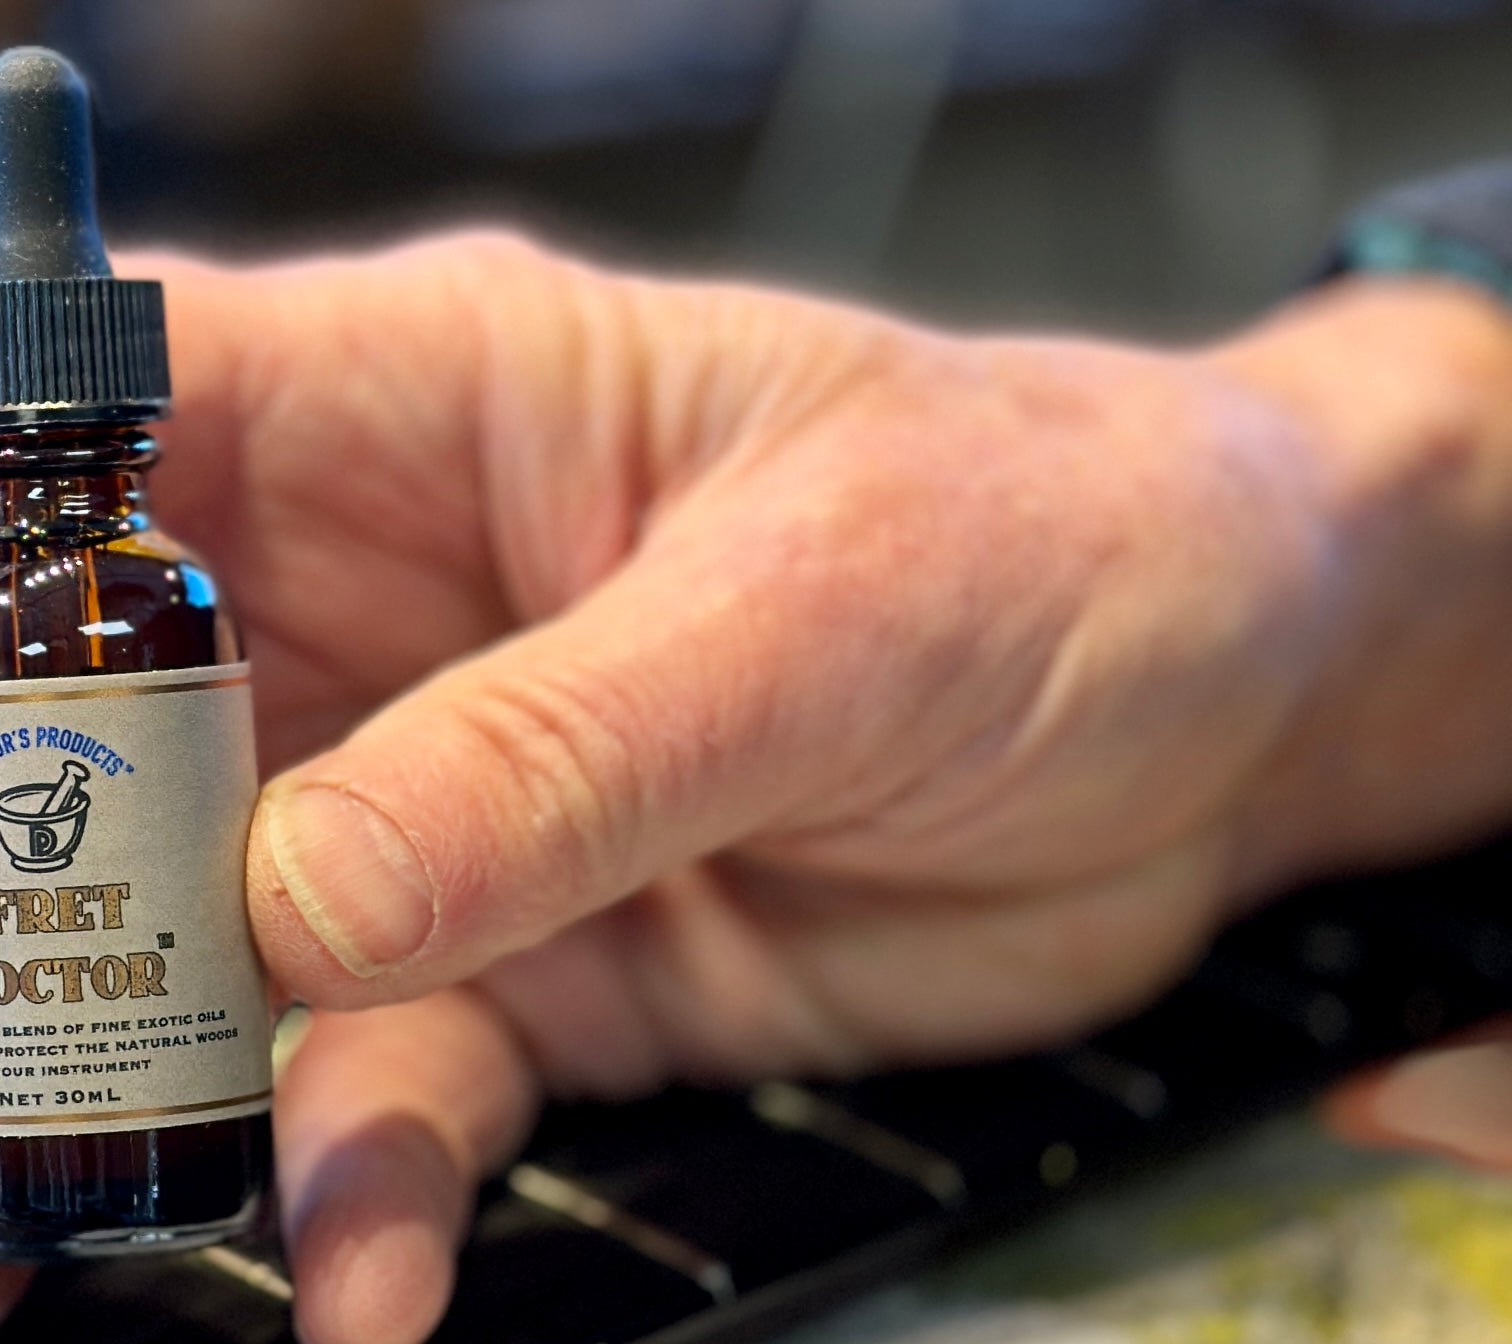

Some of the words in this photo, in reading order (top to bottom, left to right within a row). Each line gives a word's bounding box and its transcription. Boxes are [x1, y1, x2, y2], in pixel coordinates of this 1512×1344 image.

[2, 1025, 57, 1037] BLEND
[63, 1024, 85, 1035] OF
[91, 1020, 131, 1033] FINE
[137, 1014, 193, 1030] EXOTIC
[197, 1009, 226, 1023] OILS
[75, 1042, 110, 1054] THE
[115, 1035, 192, 1052] NATURAL
[196, 1027, 239, 1044] WOODS
[41, 1059, 152, 1077] INSTRUMENT
[0, 1091, 44, 1107] NET
